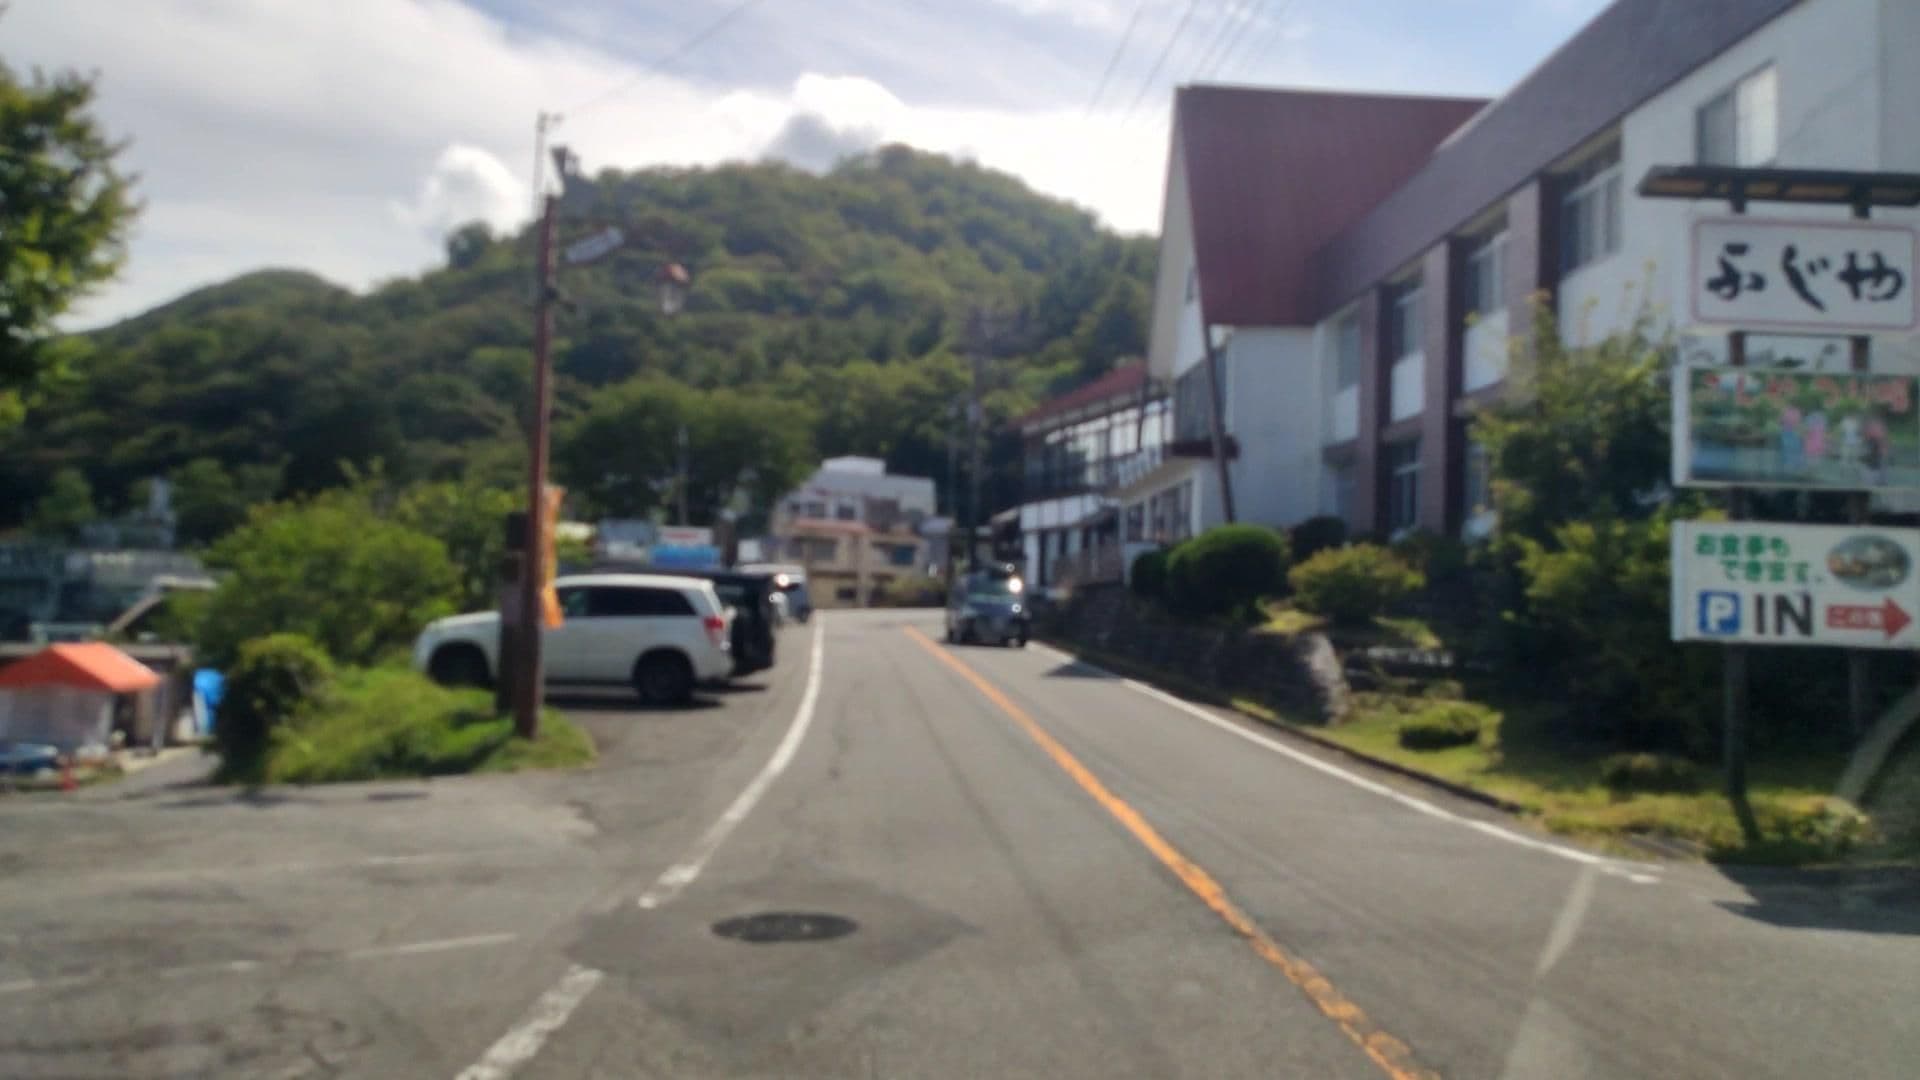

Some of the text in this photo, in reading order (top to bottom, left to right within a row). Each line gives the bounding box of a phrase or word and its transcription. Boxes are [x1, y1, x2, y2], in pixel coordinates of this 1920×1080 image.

[1706, 242, 1905, 312] ふじや
[1706, 594, 1813, 636] P IN
